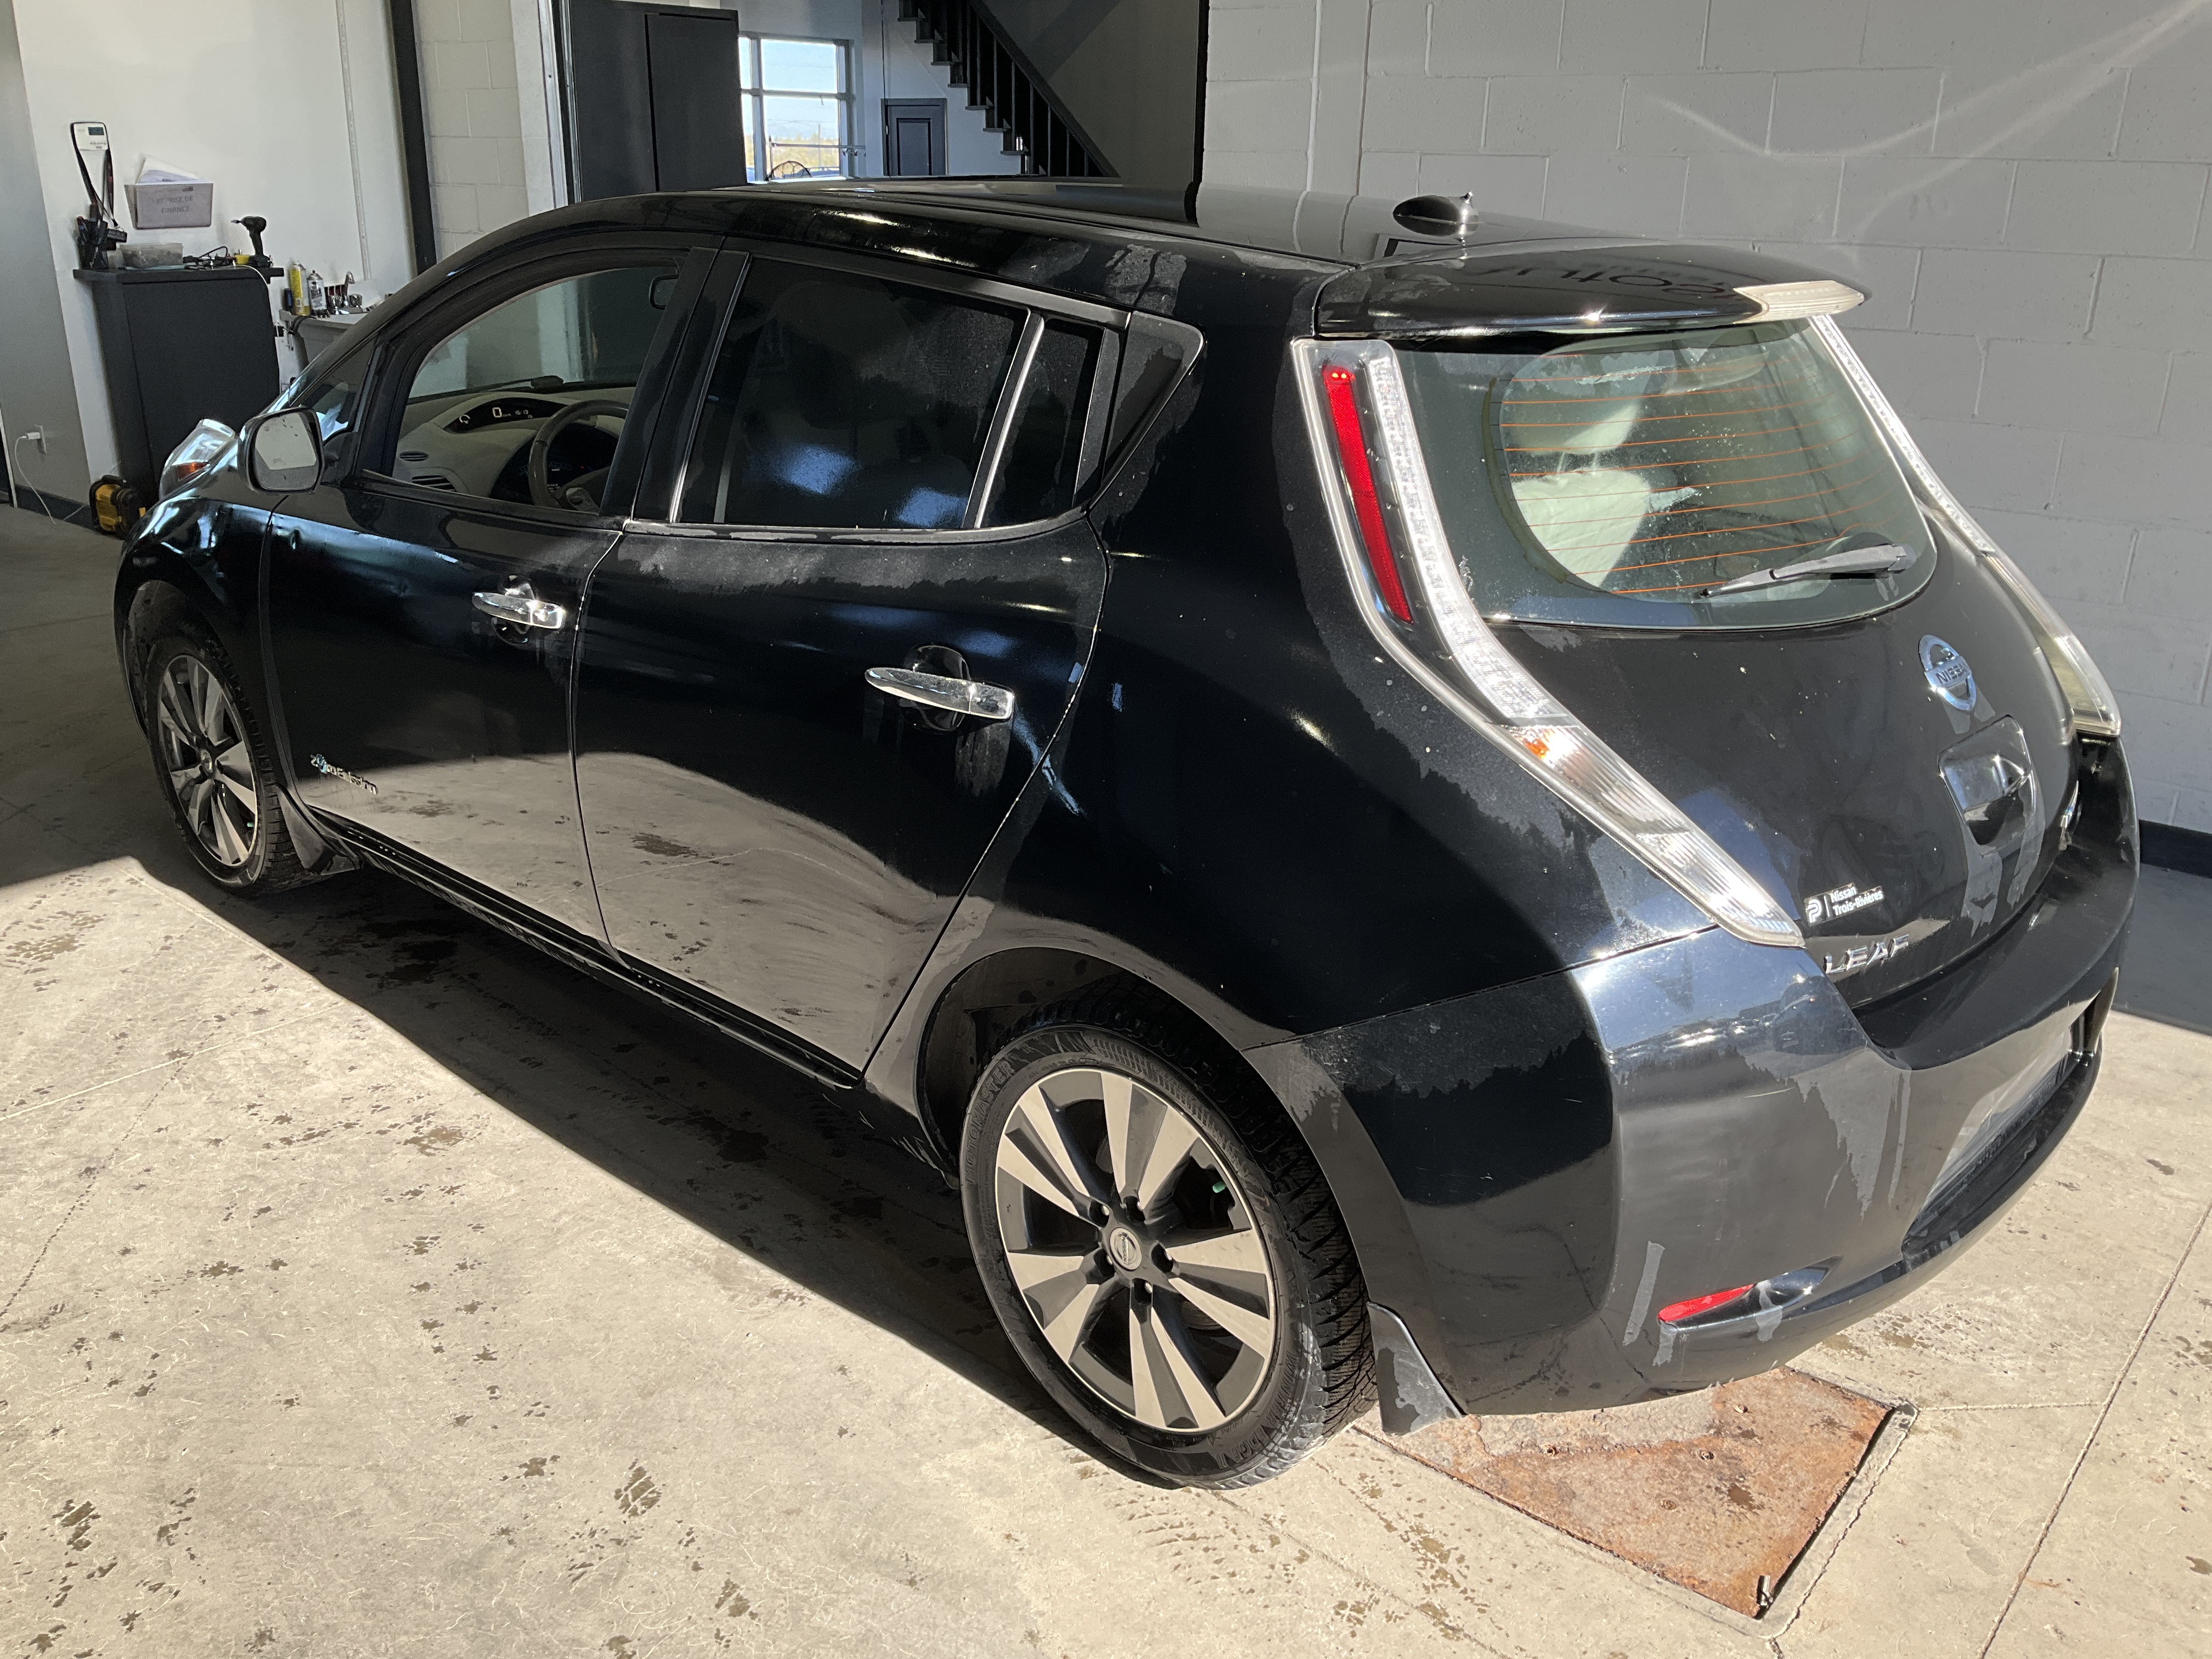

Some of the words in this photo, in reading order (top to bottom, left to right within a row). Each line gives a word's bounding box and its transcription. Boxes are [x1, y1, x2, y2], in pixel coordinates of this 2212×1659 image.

[1935, 661, 1969, 684] NISSAN
[1830, 887, 1858, 903] Nissan
[1832, 890, 1884, 916] Trois-Rivières
[1824, 934, 1909, 974] LEAF
[964, 1059, 1016, 1185] MOTOMASTER
[1266, 1350, 1299, 1429] WINTER
[1230, 1423, 1272, 1464] EDGE
